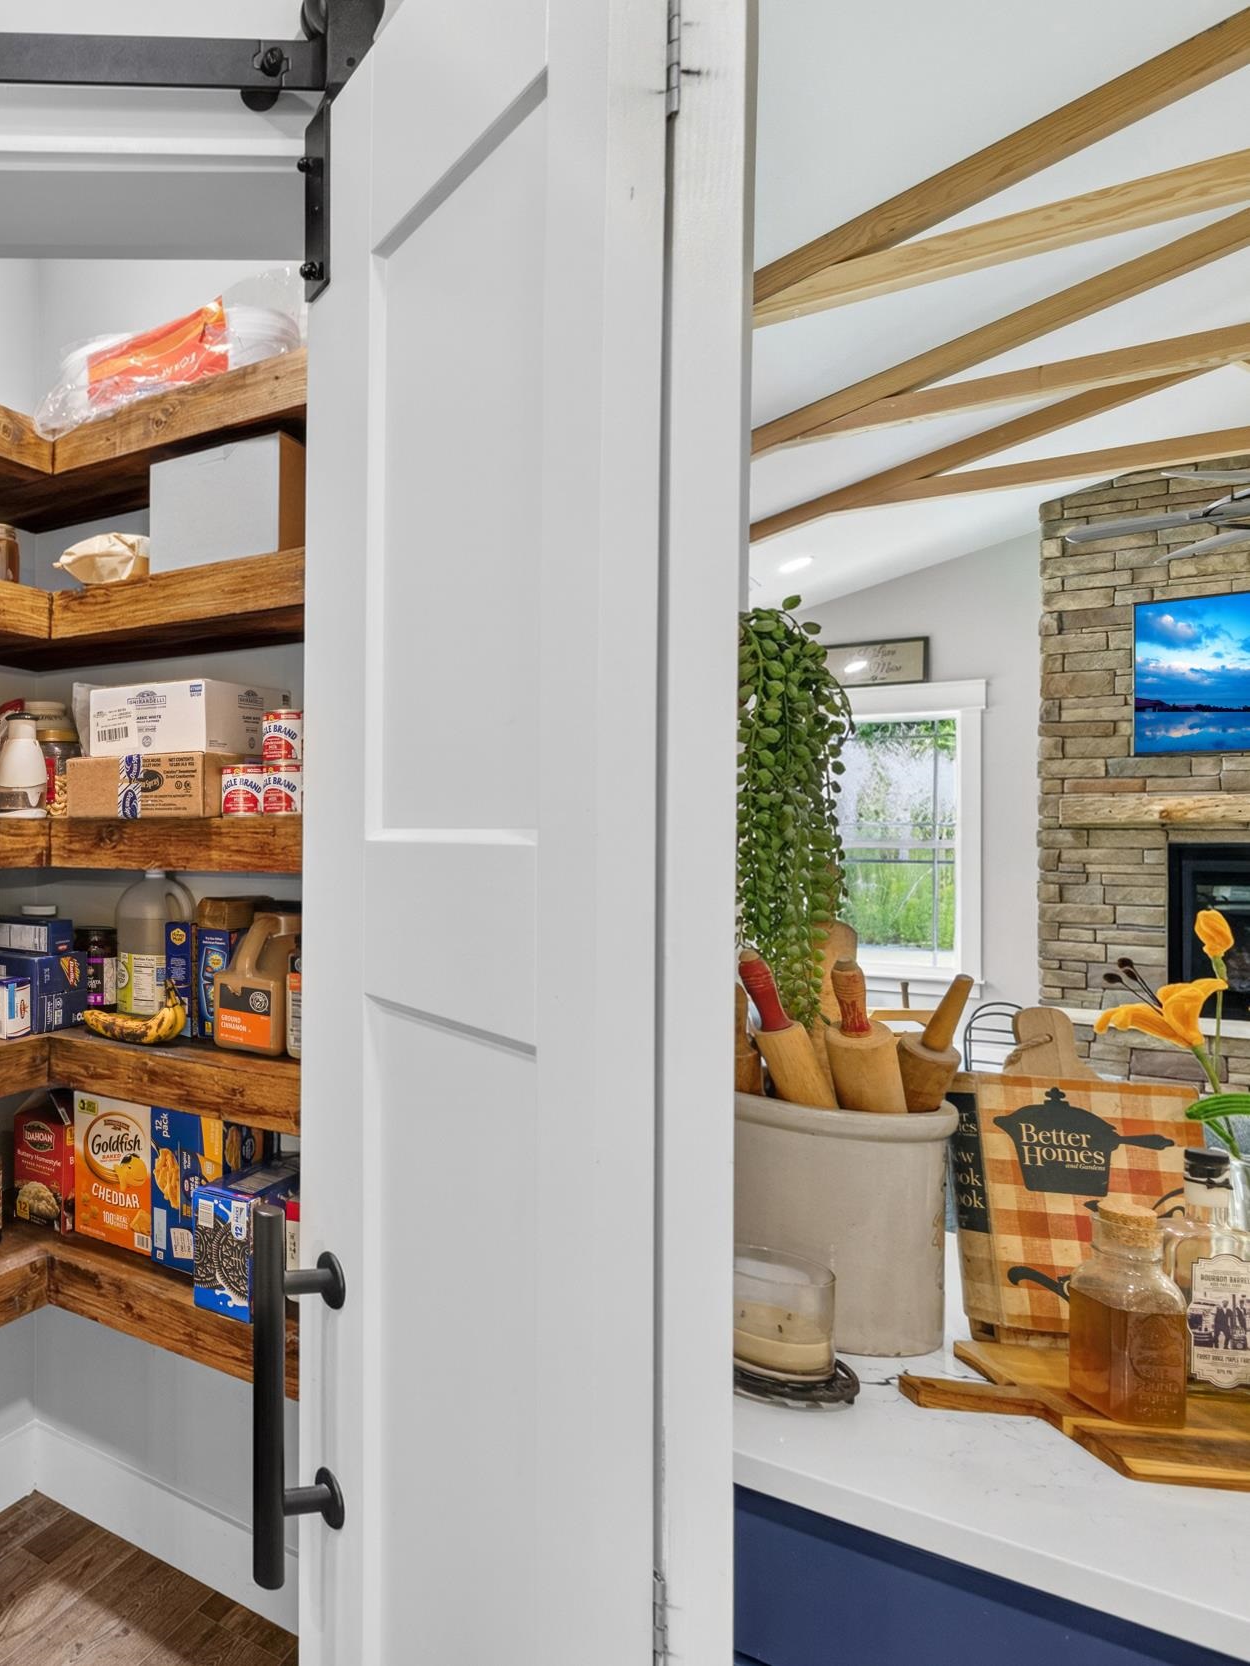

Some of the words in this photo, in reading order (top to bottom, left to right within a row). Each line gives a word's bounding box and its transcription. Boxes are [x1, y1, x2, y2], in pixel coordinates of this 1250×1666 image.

[273, 724, 298, 741] BRAND
[239, 778, 262, 794] BRAND
[272, 777, 297, 793] BRAND
[221, 1014, 242, 1024] GROUND
[221, 1021, 247, 1033] CINNAMON
[155, 1119, 163, 1131] 12
[161, 1113, 171, 1138] pack
[24, 1130, 53, 1143] IDAHOAN
[1018, 1122, 1092, 1148] Better
[91, 1132, 141, 1155] Goldfish
[17, 1148, 34, 1160] Buttery
[35, 1154, 62, 1168] Homestyle
[1022, 1145, 1106, 1167] Homes
[1078, 1163, 1106, 1172] Gardens
[91, 1182, 140, 1209] CHEDDAR
[18, 1200, 27, 1212] 12
[234, 1225, 243, 1238] 12
[1200, 1273, 1228, 1282] BOURBON
